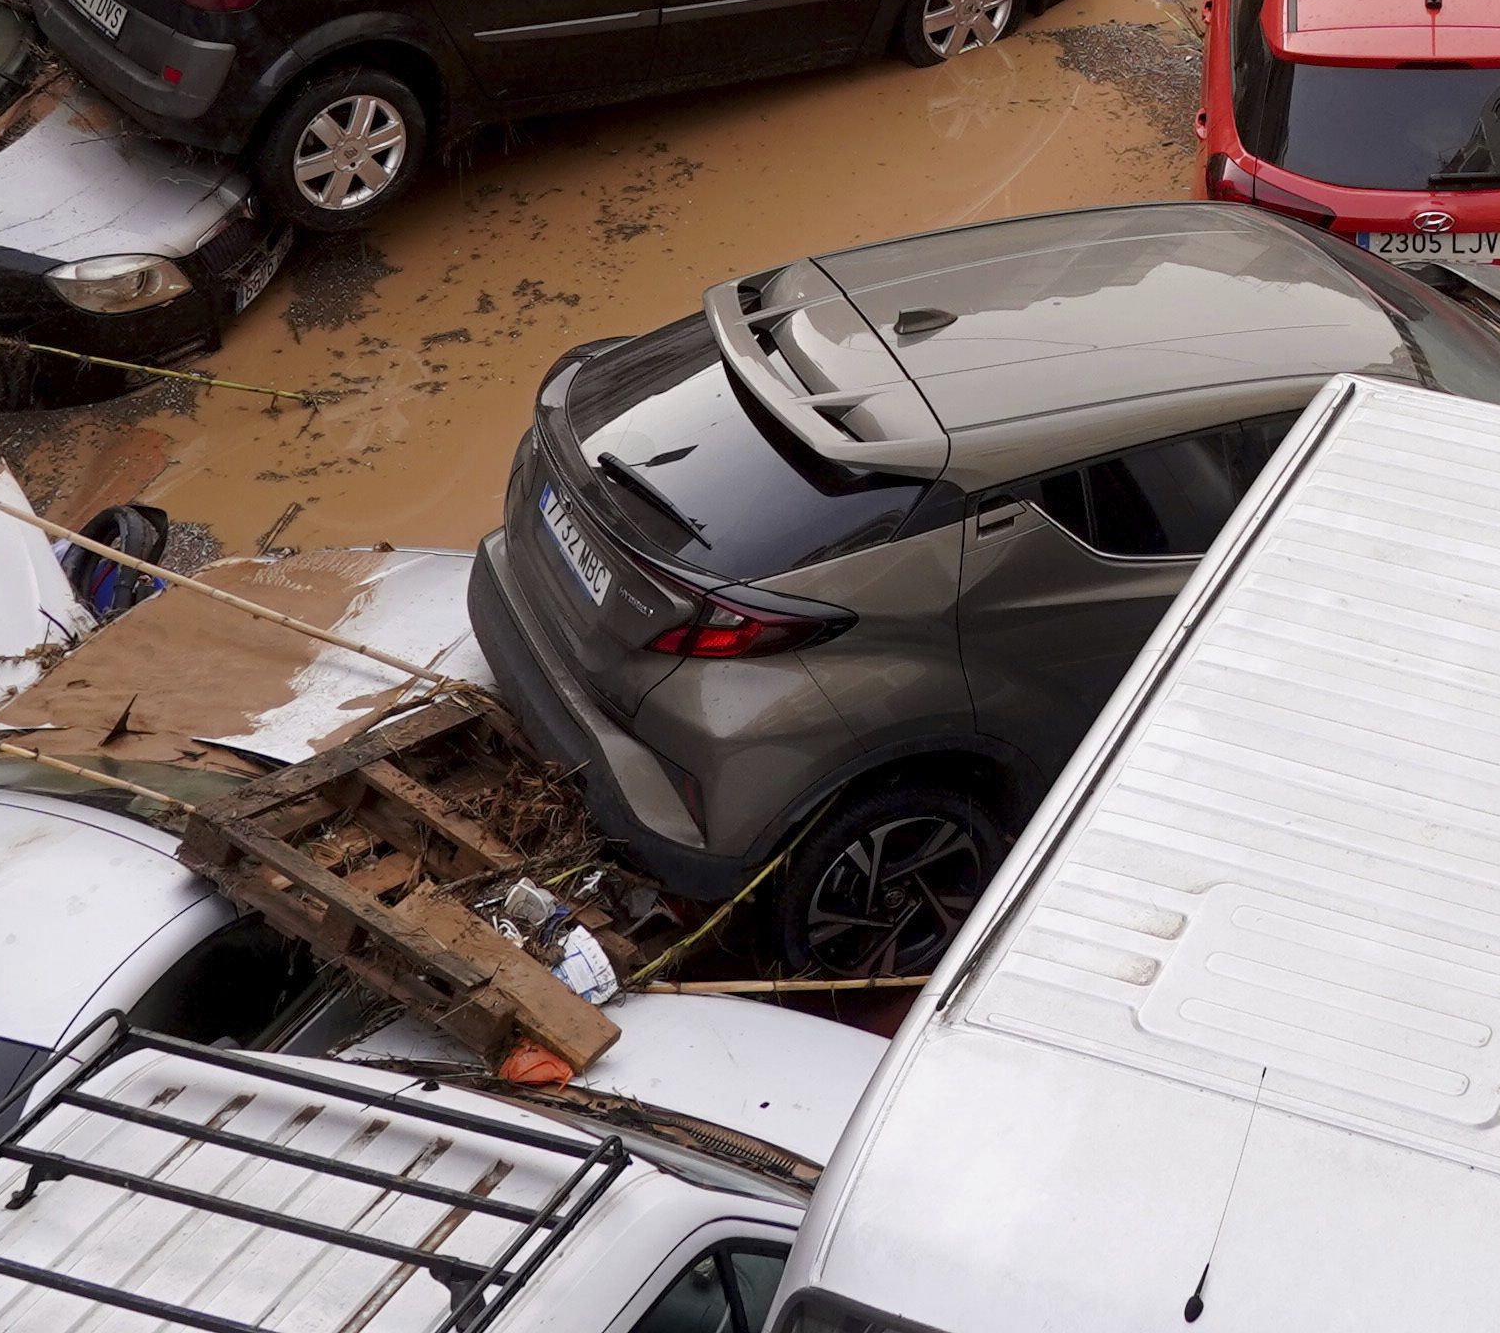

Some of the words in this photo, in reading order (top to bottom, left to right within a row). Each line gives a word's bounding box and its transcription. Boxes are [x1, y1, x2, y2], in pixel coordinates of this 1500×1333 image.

[1380, 234, 1444, 255] 2305
[1449, 234, 1500, 255] LJV
[577, 544, 607, 594] MBC
